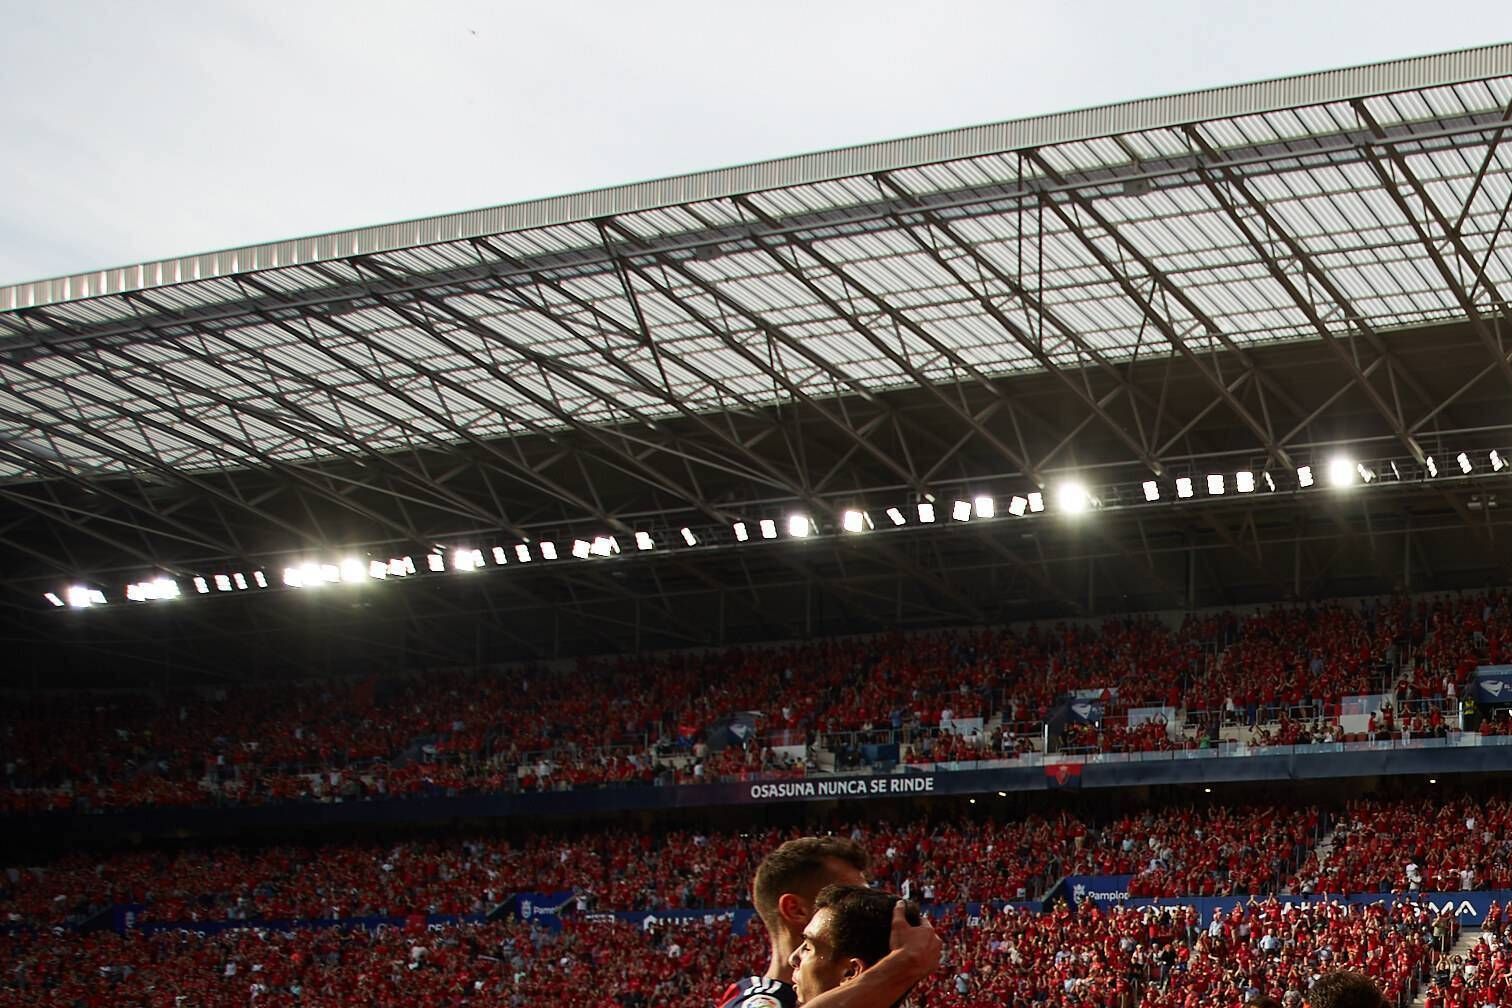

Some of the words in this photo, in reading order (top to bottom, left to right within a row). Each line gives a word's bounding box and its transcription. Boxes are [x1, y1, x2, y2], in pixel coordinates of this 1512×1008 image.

[751, 783, 815, 798] OSASUNA
[818, 780, 867, 795] NUNCA
[870, 779, 887, 793] SE
[890, 777, 934, 792] RINDE
